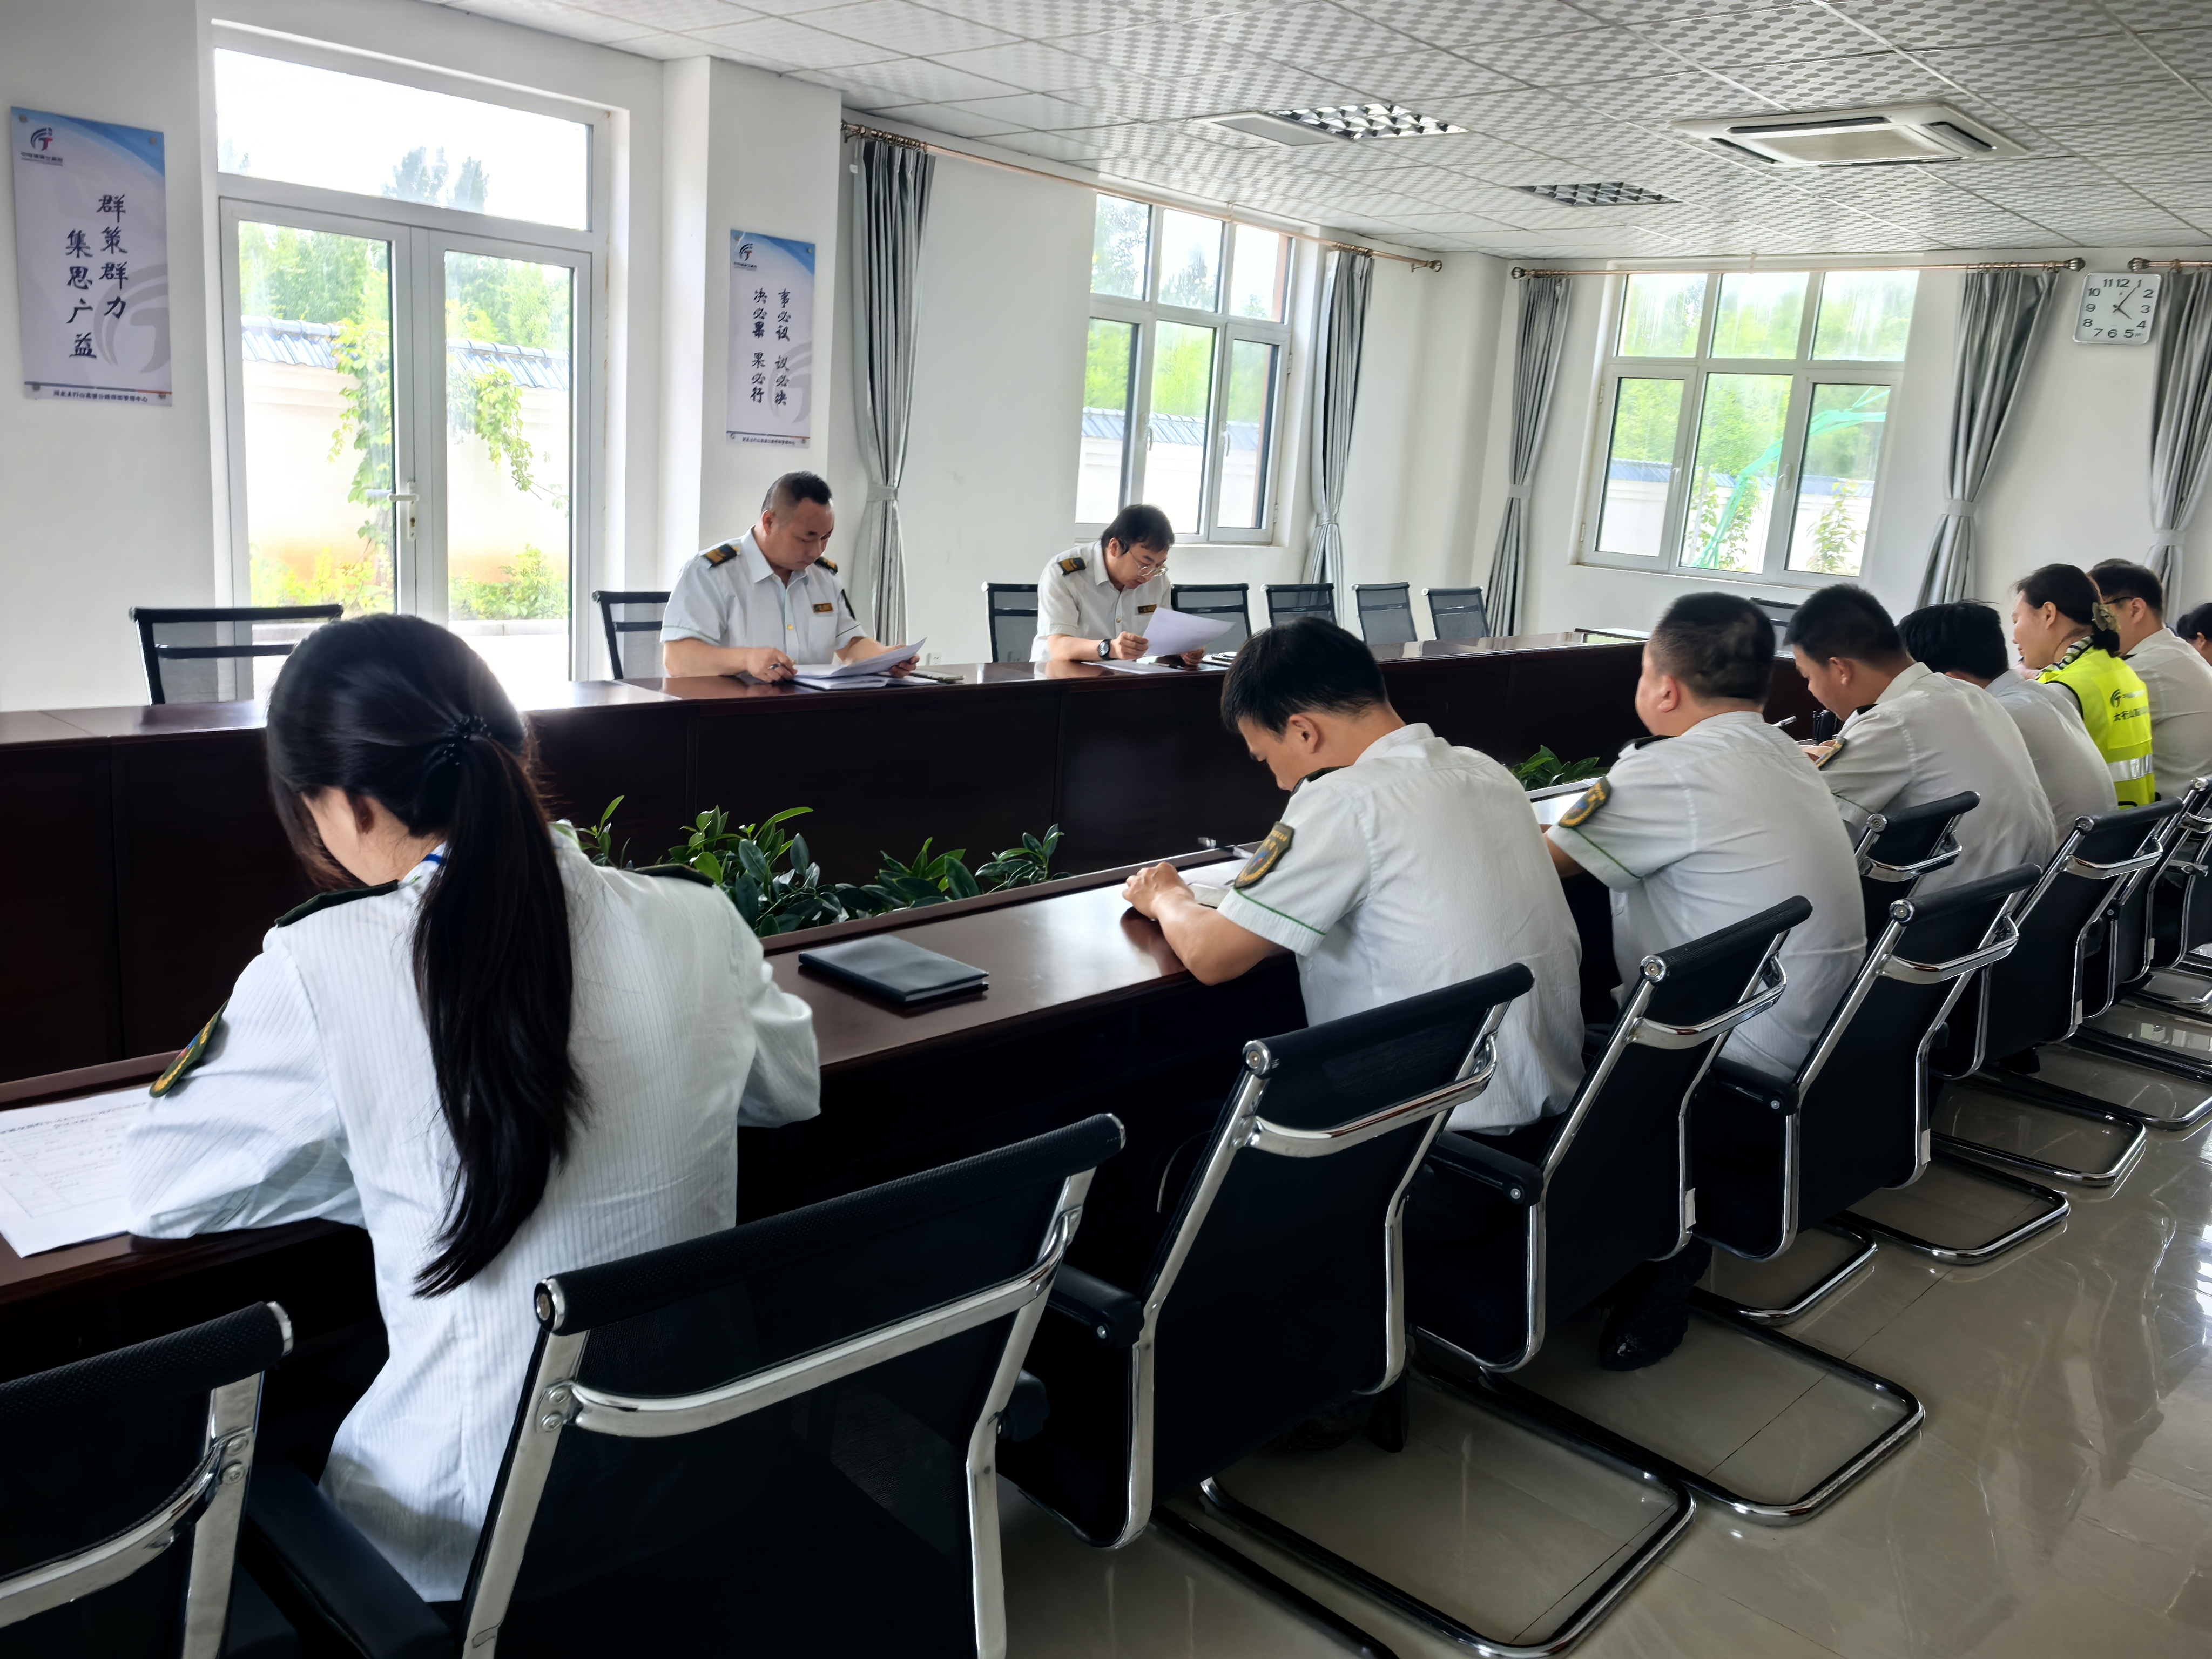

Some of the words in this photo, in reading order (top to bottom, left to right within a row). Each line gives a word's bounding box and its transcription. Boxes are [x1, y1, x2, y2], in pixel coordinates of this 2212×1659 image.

[96, 193, 129, 320] 群策群力
[2103, 279, 2114, 287] 11
[2116, 278, 2130, 288] 12
[2137, 278, 2143, 288] 1
[65, 228, 98, 359] 集思广益
[2087, 288, 2101, 296] 10
[2143, 289, 2154, 298] 2
[2085, 304, 2096, 312] 9
[2141, 305, 2151, 314] 3
[751, 287, 768, 339] 决必果
[775, 287, 791, 342] 事必议
[2082, 318, 2093, 327] 8
[2136, 320, 2147, 329] 4
[2093, 328, 2104, 338] 7
[2107, 329, 2117, 338] 6
[2123, 329, 2135, 338] 5
[750, 352, 766, 404] 果必行
[773, 354, 790, 406] 议必决
